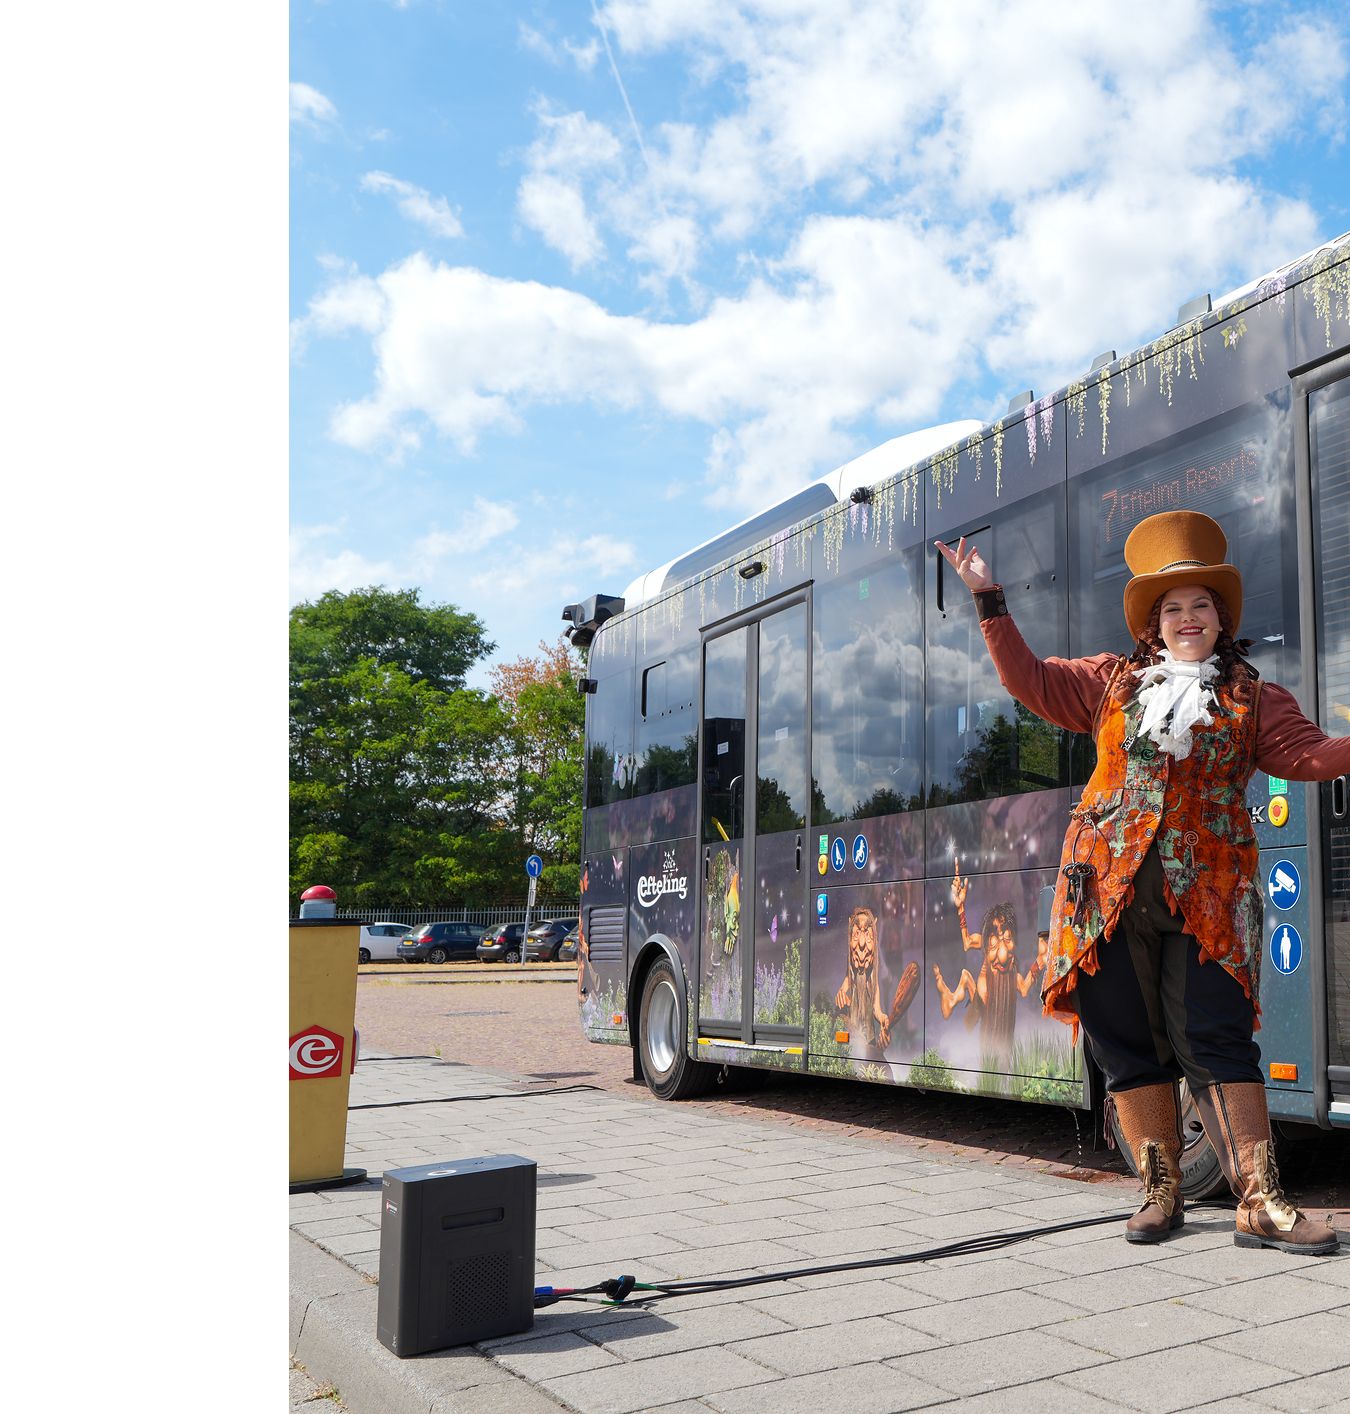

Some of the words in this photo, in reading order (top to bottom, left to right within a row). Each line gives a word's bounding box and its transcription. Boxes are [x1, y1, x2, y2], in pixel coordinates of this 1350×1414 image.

[1102, 489, 1118, 542] 7
[1121, 480, 1180, 522] Efteling
[1186, 449, 1258, 498] Resorts
[637, 874, 688, 908] efteling
